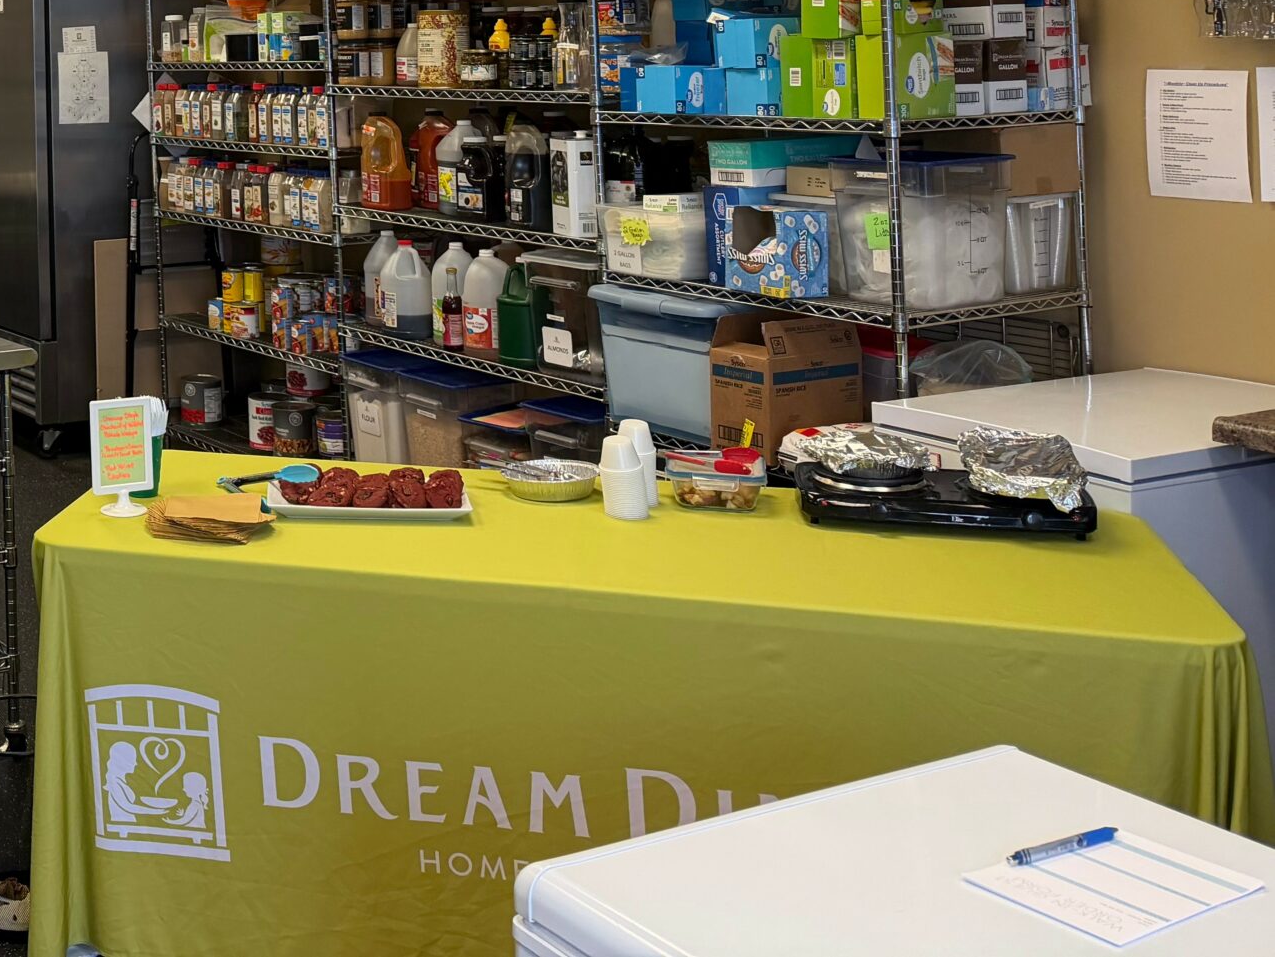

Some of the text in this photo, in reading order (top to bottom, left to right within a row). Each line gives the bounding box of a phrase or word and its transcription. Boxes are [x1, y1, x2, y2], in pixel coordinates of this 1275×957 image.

[727, 158, 748, 166] GALLON
[873, 217, 879, 226] 2
[714, 222, 722, 265] ASSORTMENT
[617, 250, 636, 258] GALLON
[727, 247, 775, 266] SWISS MISS
[799, 229, 808, 281] SWISS MISS
[547, 345, 569, 355] ALMONDS
[731, 358, 746, 367] Sysco
[723, 366, 753, 380] Imperial
[715, 379, 734, 387] SPANISH
[775, 386, 796, 394] SPANISH
[362, 414, 376, 423] FLOUR
[257, 735, 591, 839] DREAM
